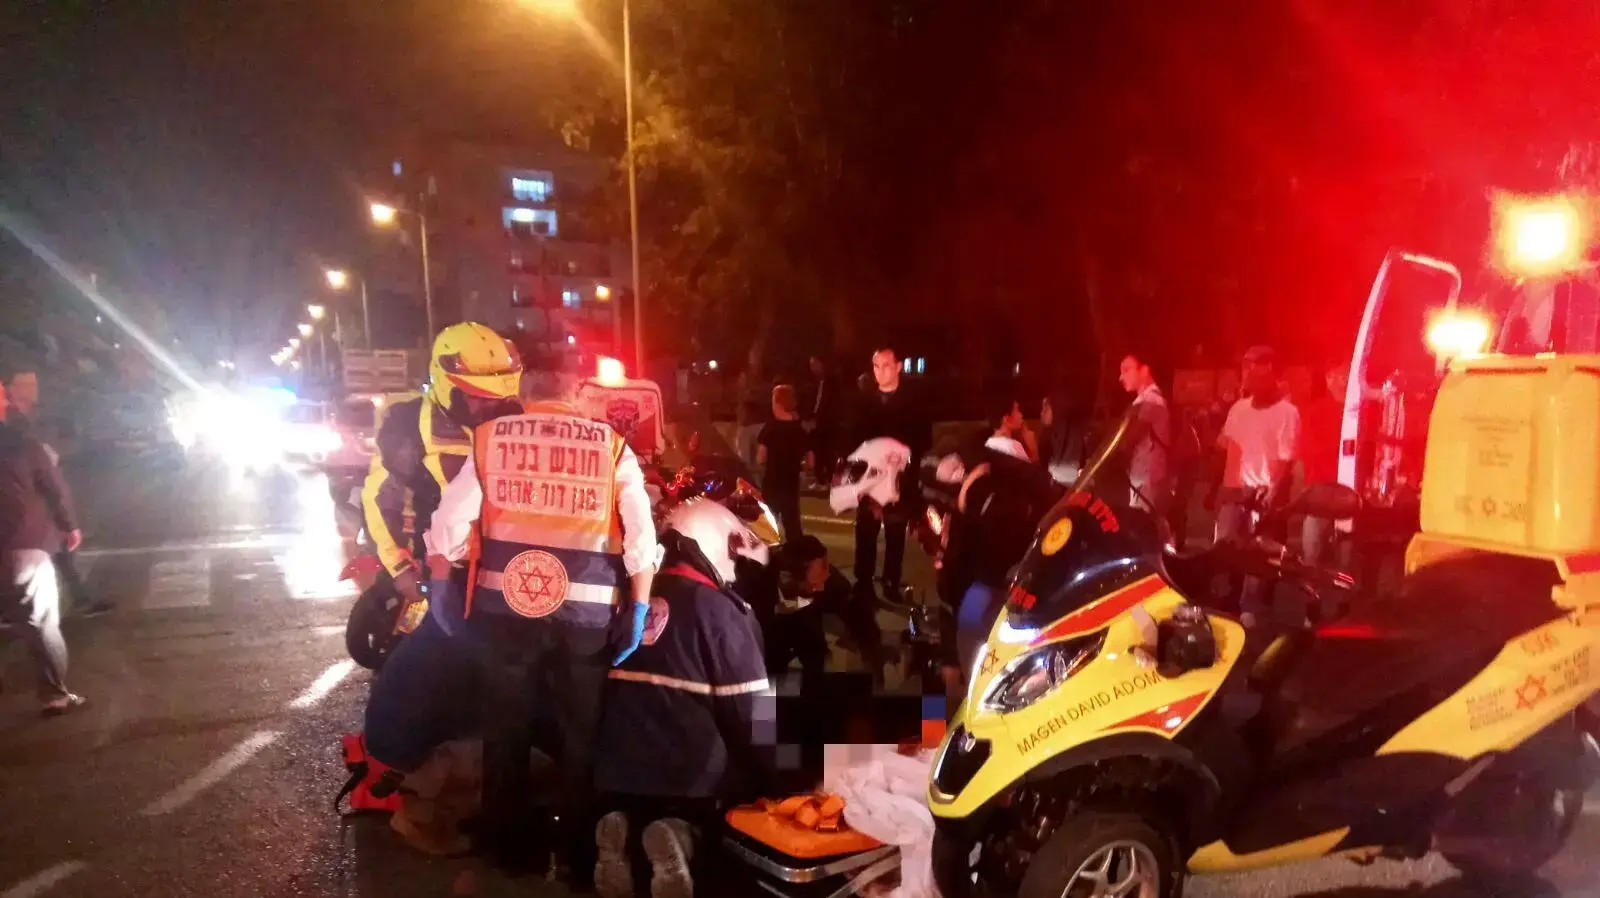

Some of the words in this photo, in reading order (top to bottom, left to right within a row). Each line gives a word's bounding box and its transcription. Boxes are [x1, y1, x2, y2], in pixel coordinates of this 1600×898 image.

[494, 419, 537, 436] דרום
[559, 418, 605, 442] הצלה
[497, 442, 539, 472] בכיר
[549, 446, 600, 477] חובש
[496, 479, 533, 504] אדום
[541, 482, 566, 509] דוד
[572, 486, 598, 514] מגן
[1016, 714, 1068, 756] MAGEN
[1066, 690, 1111, 721] DAVID
[1112, 669, 1161, 699] ADOM
